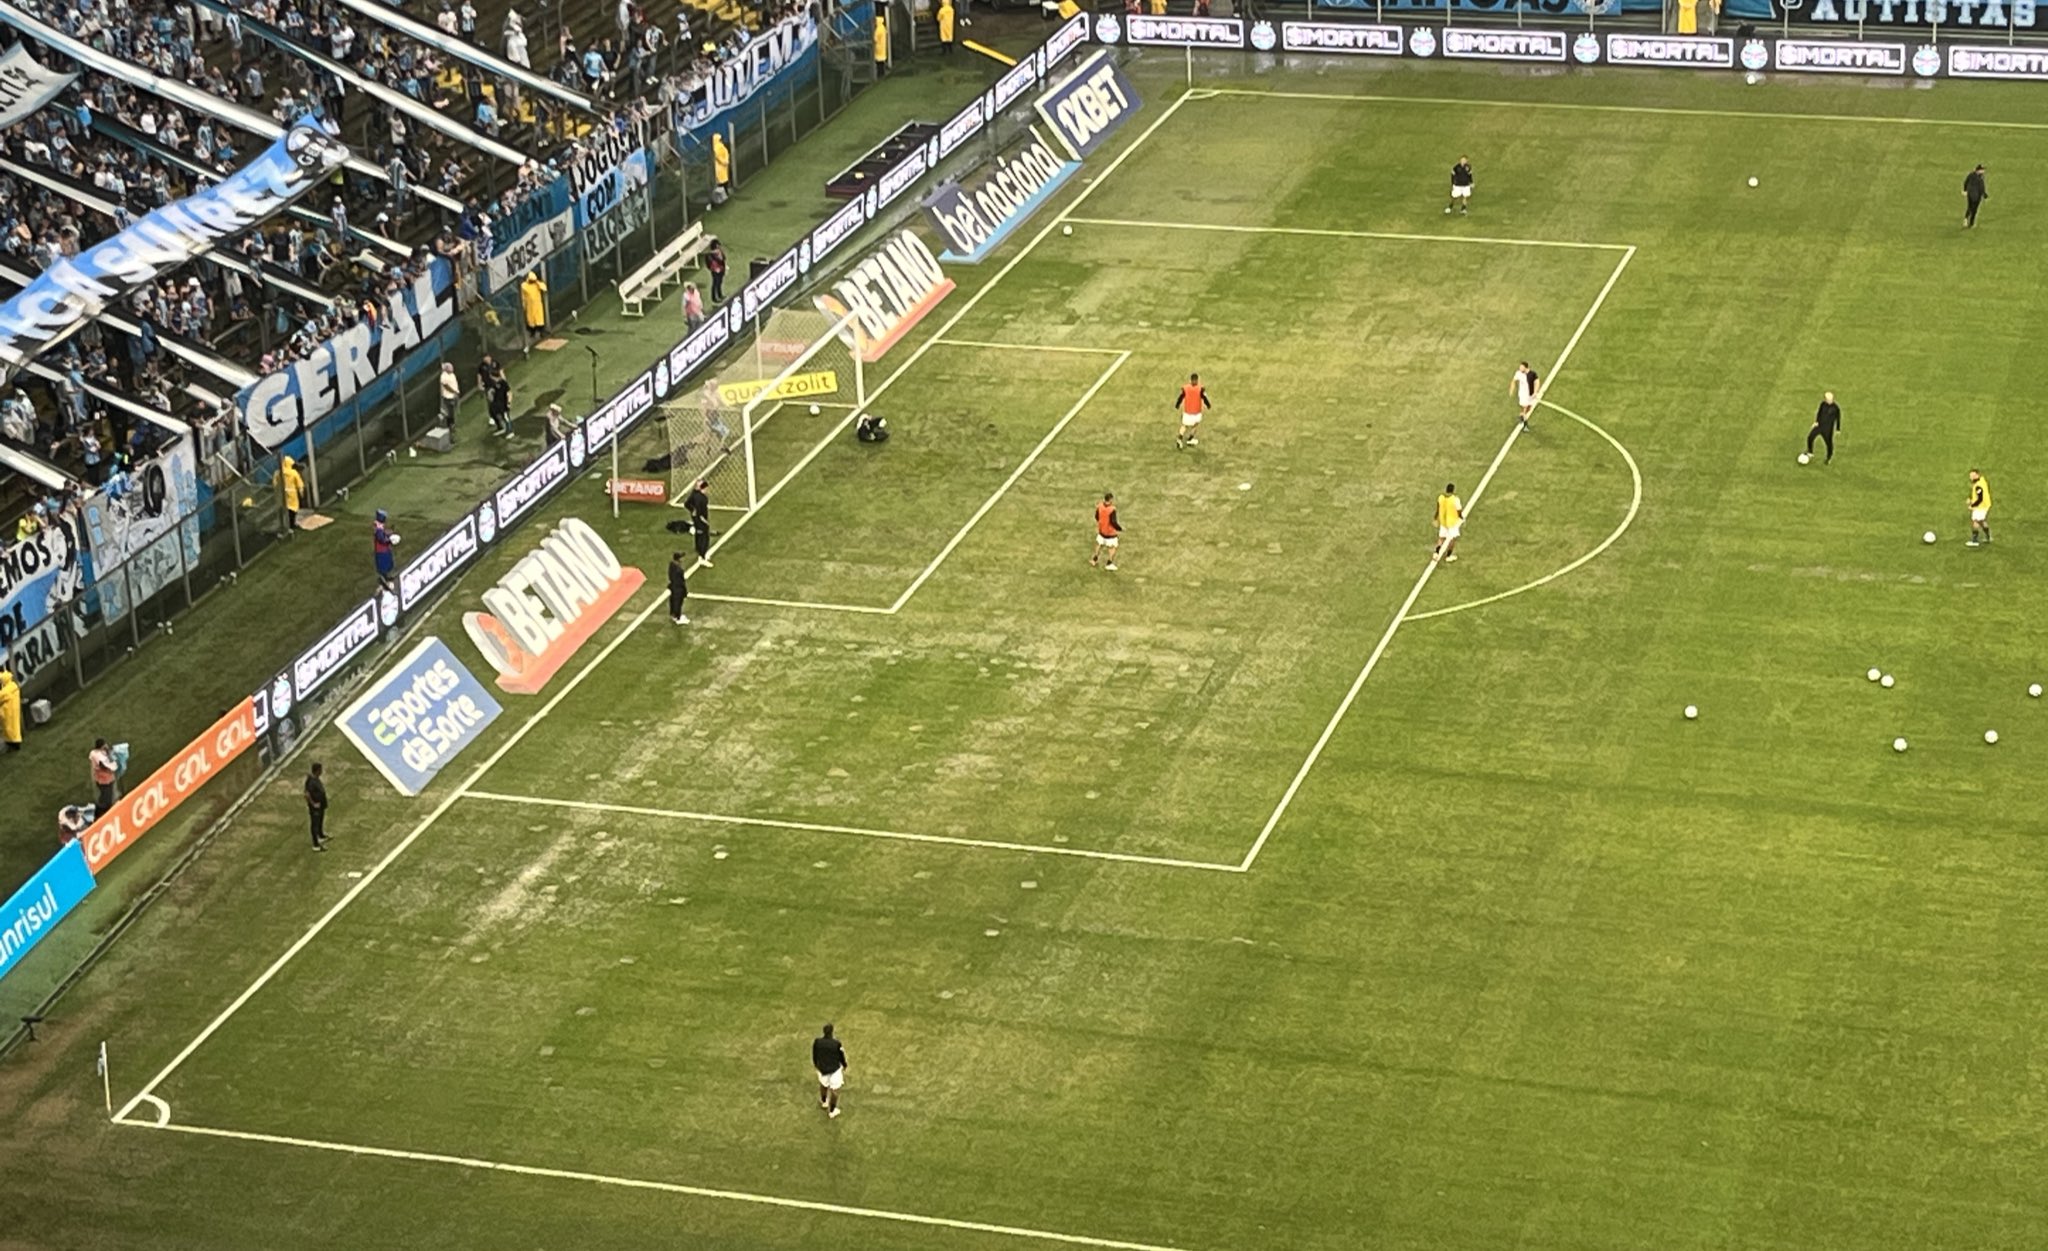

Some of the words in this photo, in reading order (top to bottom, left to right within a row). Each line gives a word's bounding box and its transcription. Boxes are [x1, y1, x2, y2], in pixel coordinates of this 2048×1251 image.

[1811, 0, 2036, 27] AUTISTAS
[697, 22, 793, 121] JOVEM
[1056, 64, 1128, 147] 1XBET
[587, 172, 616, 220] COM
[837, 229, 946, 341] BETANO
[246, 268, 453, 447] GERAL
[486, 518, 622, 656] BETANO
[368, 659, 459, 746] Esportes
[87, 816, 127, 864] GOL
[131, 782, 169, 828] GOL
[174, 747, 211, 792] GOL
[216, 714, 251, 758] GOL
